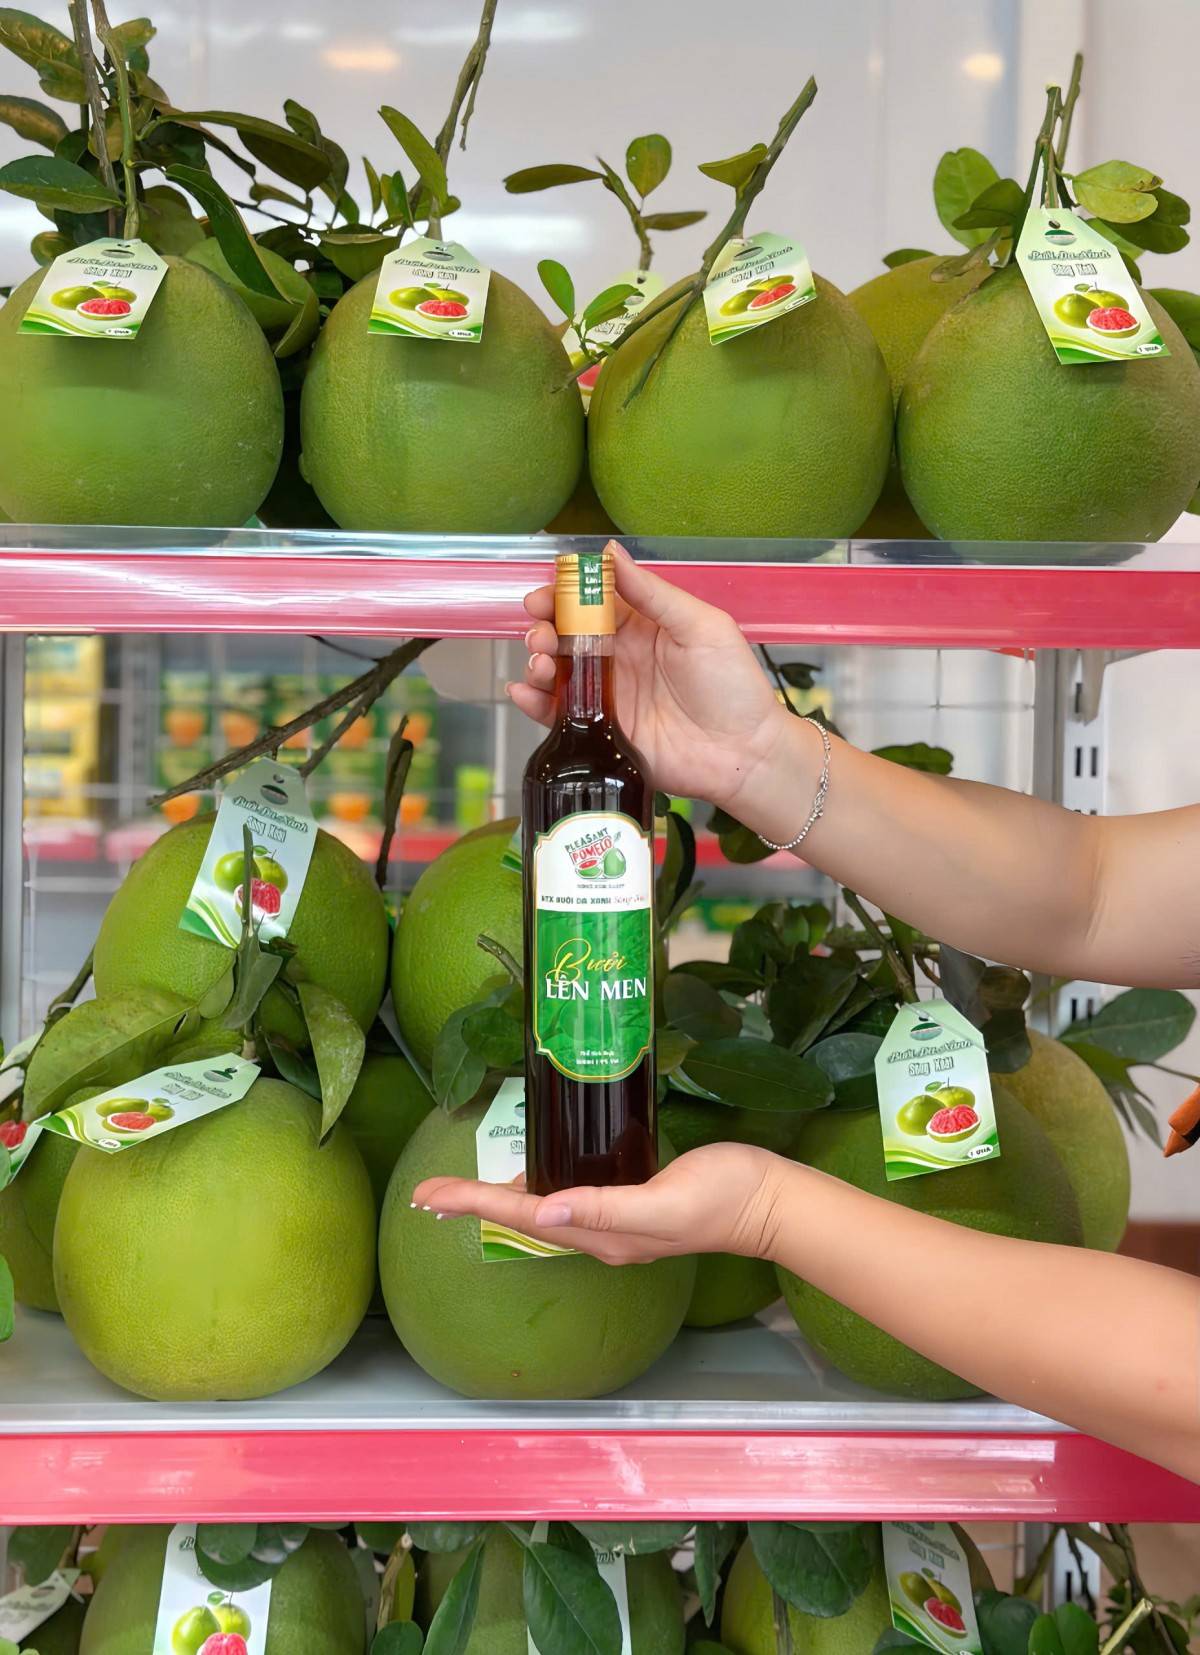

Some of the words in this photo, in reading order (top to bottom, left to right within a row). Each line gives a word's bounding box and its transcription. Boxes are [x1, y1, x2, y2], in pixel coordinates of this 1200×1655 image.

[565, 827, 608, 852] PLEASANT
[572, 838, 612, 862] POMELO
[546, 938, 627, 987] Bưởi
[546, 974, 589, 1000] LÊN
[601, 977, 646, 1000] MEN
